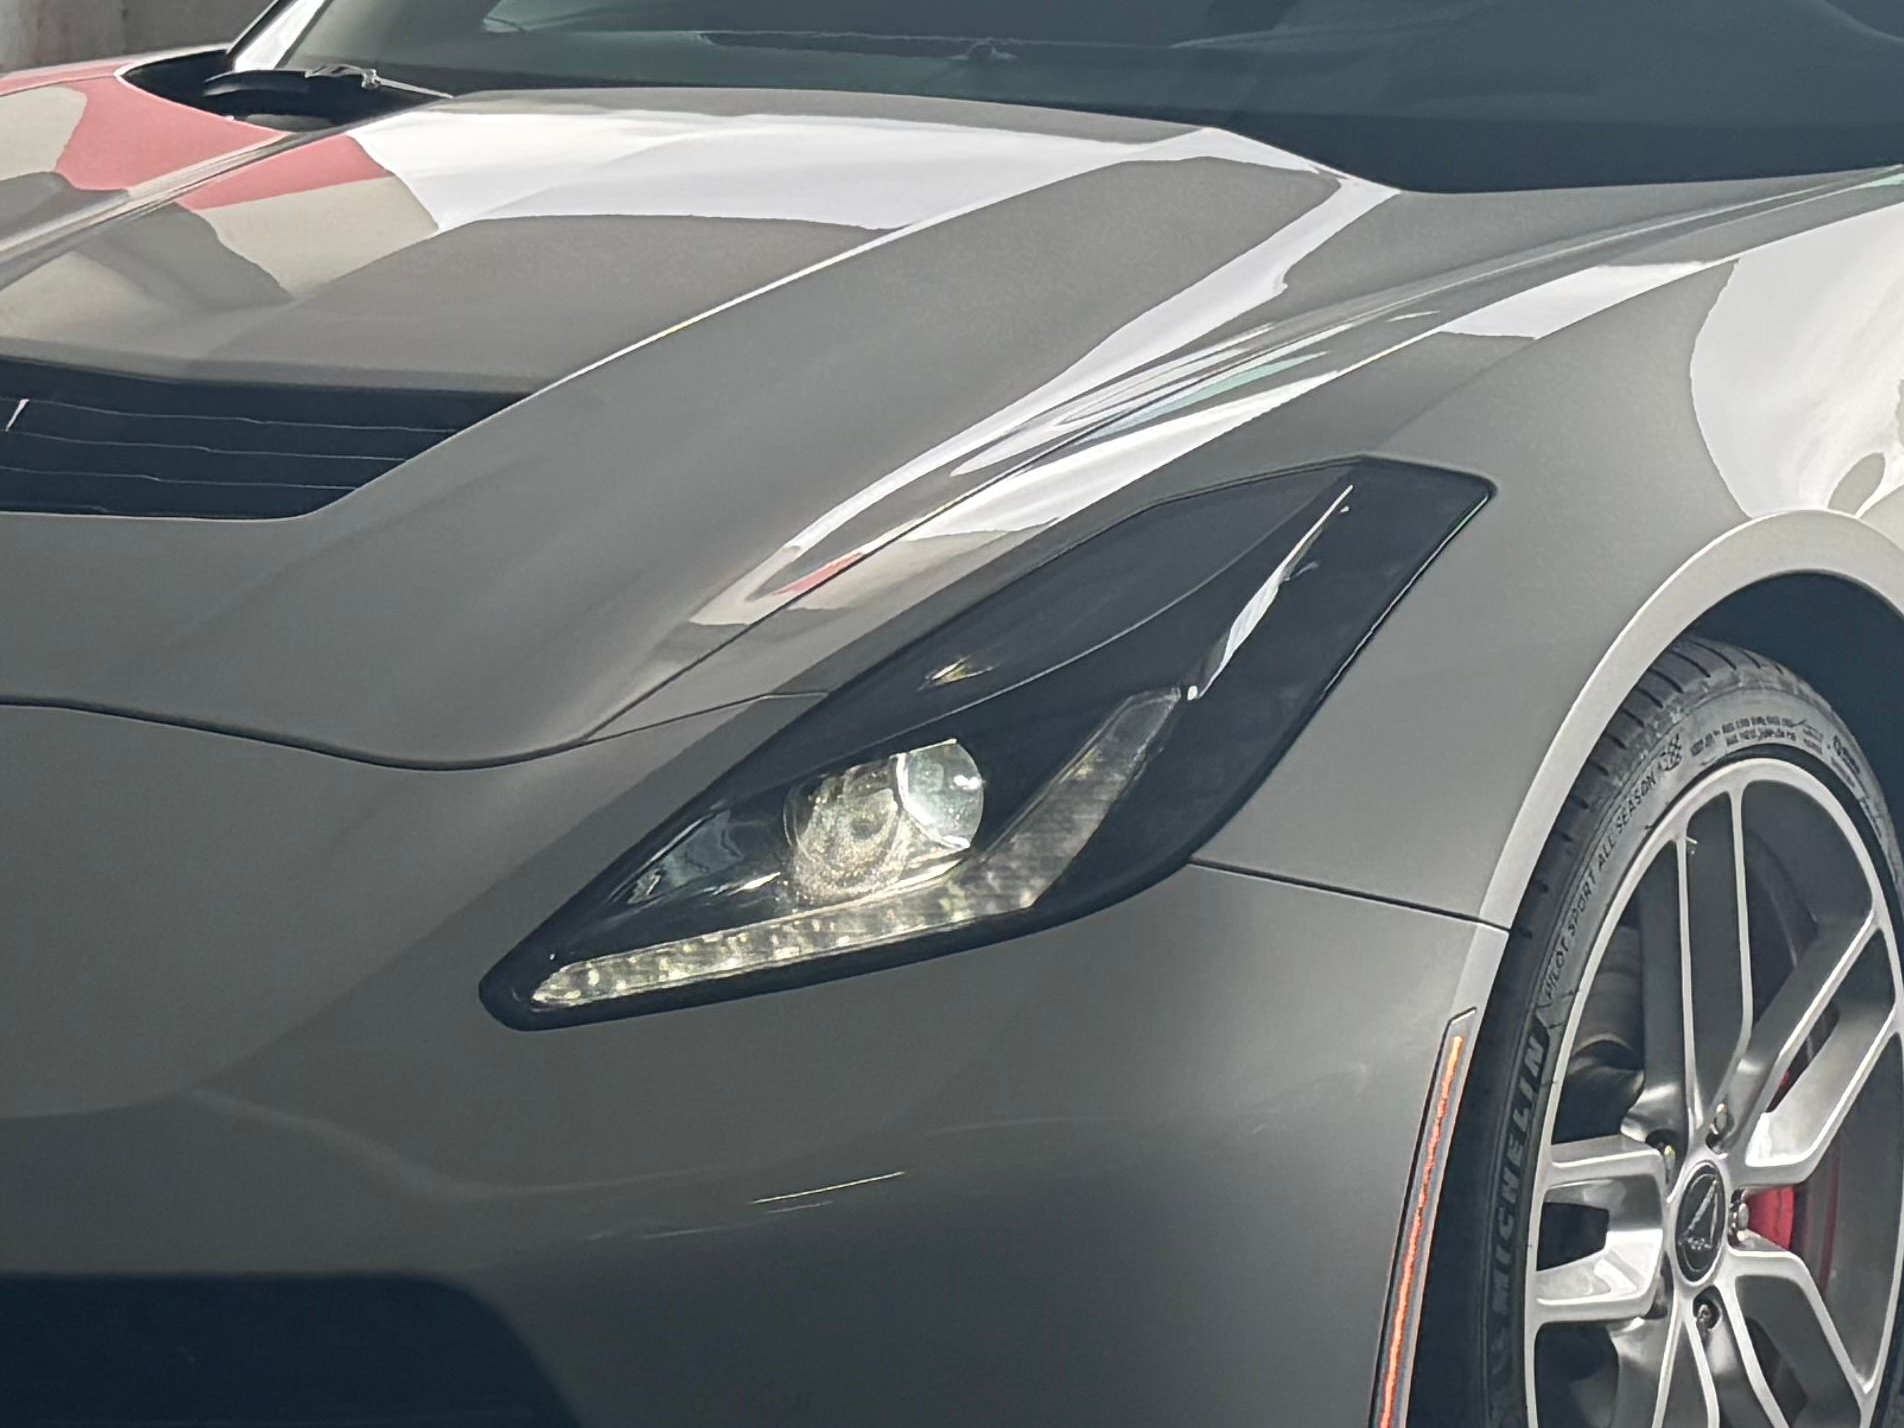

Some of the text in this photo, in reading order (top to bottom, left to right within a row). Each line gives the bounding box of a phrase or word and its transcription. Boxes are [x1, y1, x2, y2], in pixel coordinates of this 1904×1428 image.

[1546, 767, 1658, 999] PILOT SPORT ALL SEASON
[1492, 1037, 1545, 1317] MICHELIN
